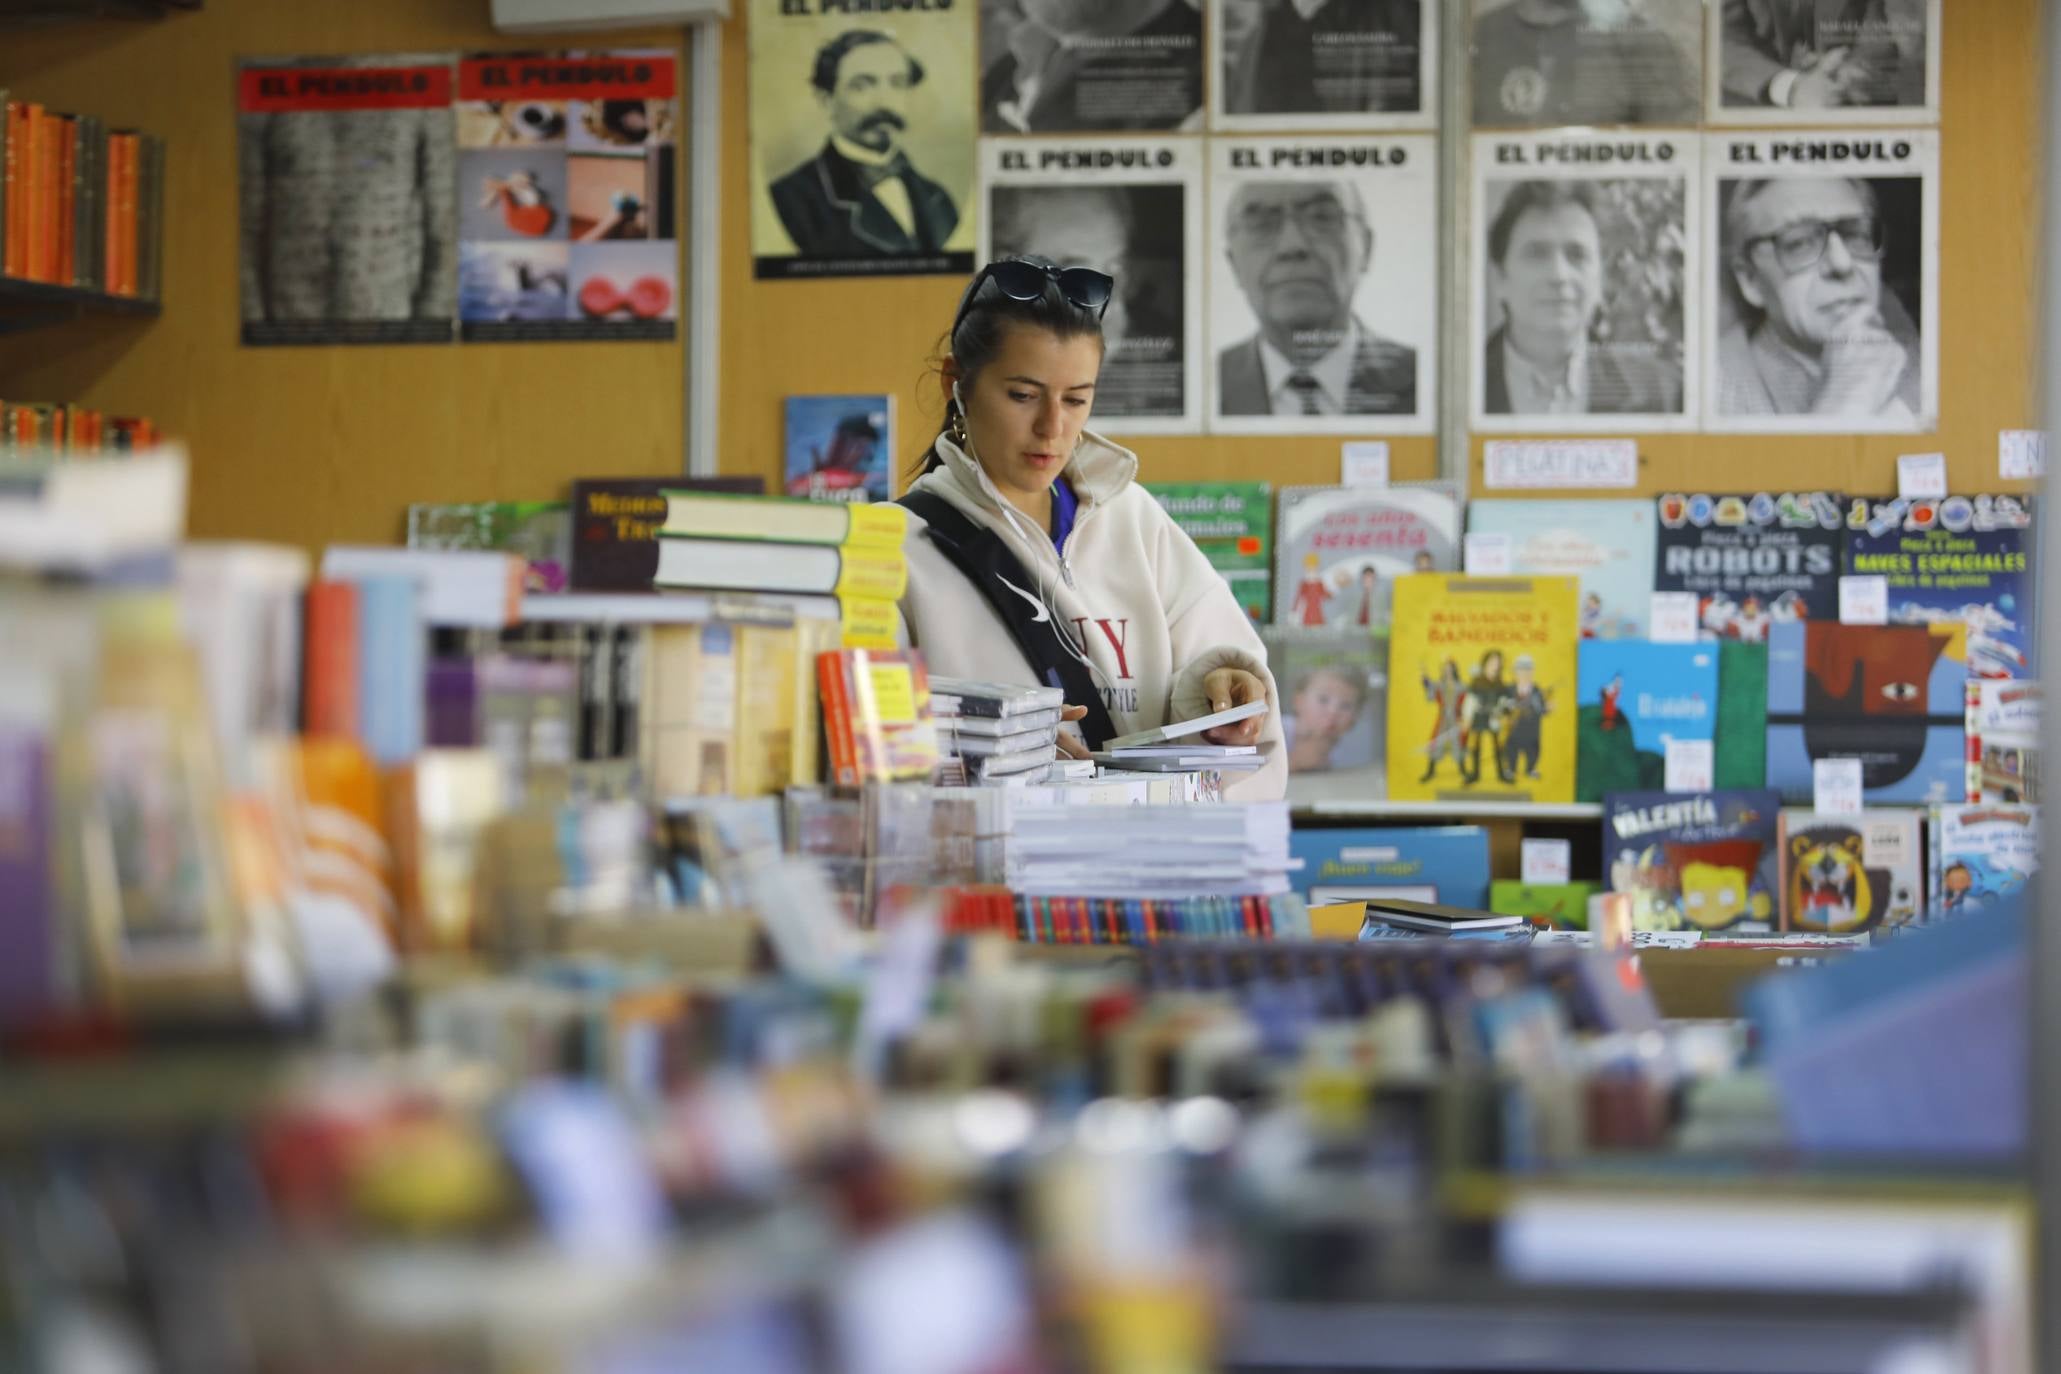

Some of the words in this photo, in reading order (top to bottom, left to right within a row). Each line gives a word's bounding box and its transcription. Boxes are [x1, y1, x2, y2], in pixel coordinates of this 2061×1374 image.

[260, 75, 289, 96] EL
[481, 66, 512, 87] EL
[1000, 151, 1029, 170] EL
[1231, 149, 1260, 168] EL
[1496, 143, 1527, 163] EL
[1729, 142, 1761, 163] EL
[1665, 545, 1832, 576] ROBOTS
[1854, 553, 1911, 573] NAVES
[1917, 551, 2026, 573] ESPACIALES
[1427, 626, 1549, 643] BANDIDOS
[1611, 794, 1718, 839] VALENTÍA
